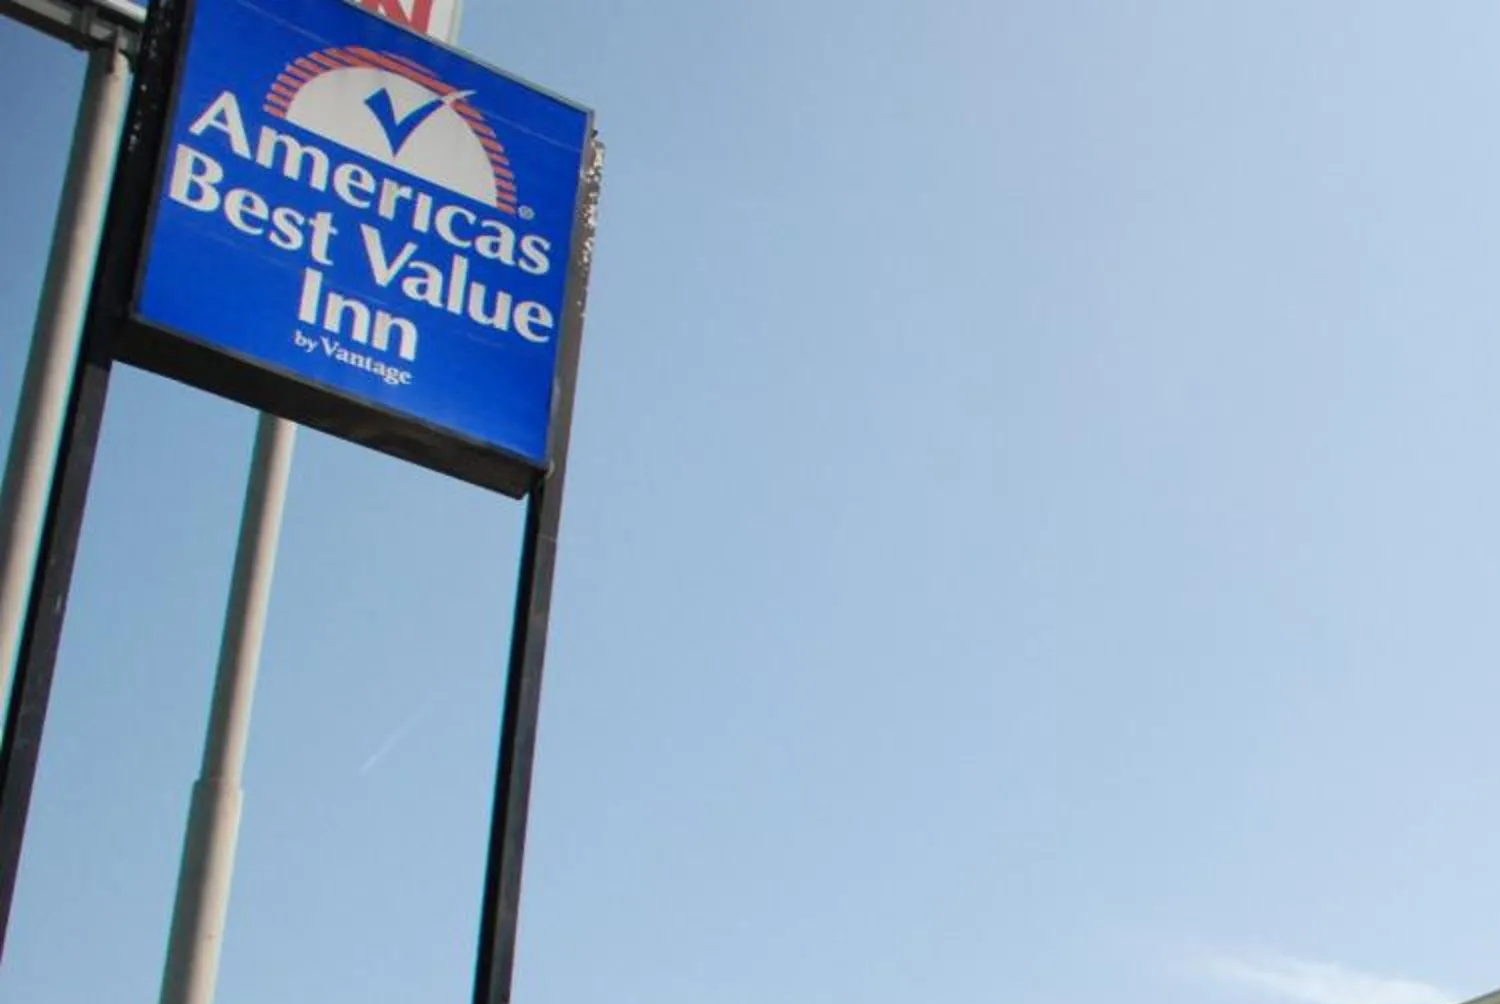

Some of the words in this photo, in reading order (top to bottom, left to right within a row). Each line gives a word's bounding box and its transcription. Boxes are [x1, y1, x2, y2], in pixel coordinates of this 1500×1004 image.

[168, 143, 339, 266] Best
[360, 223, 554, 343] Value
[189, 90, 552, 275] Americas
[294, 329, 319, 353] by
[320, 336, 413, 385] Vantage
[298, 267, 417, 362] Inn
